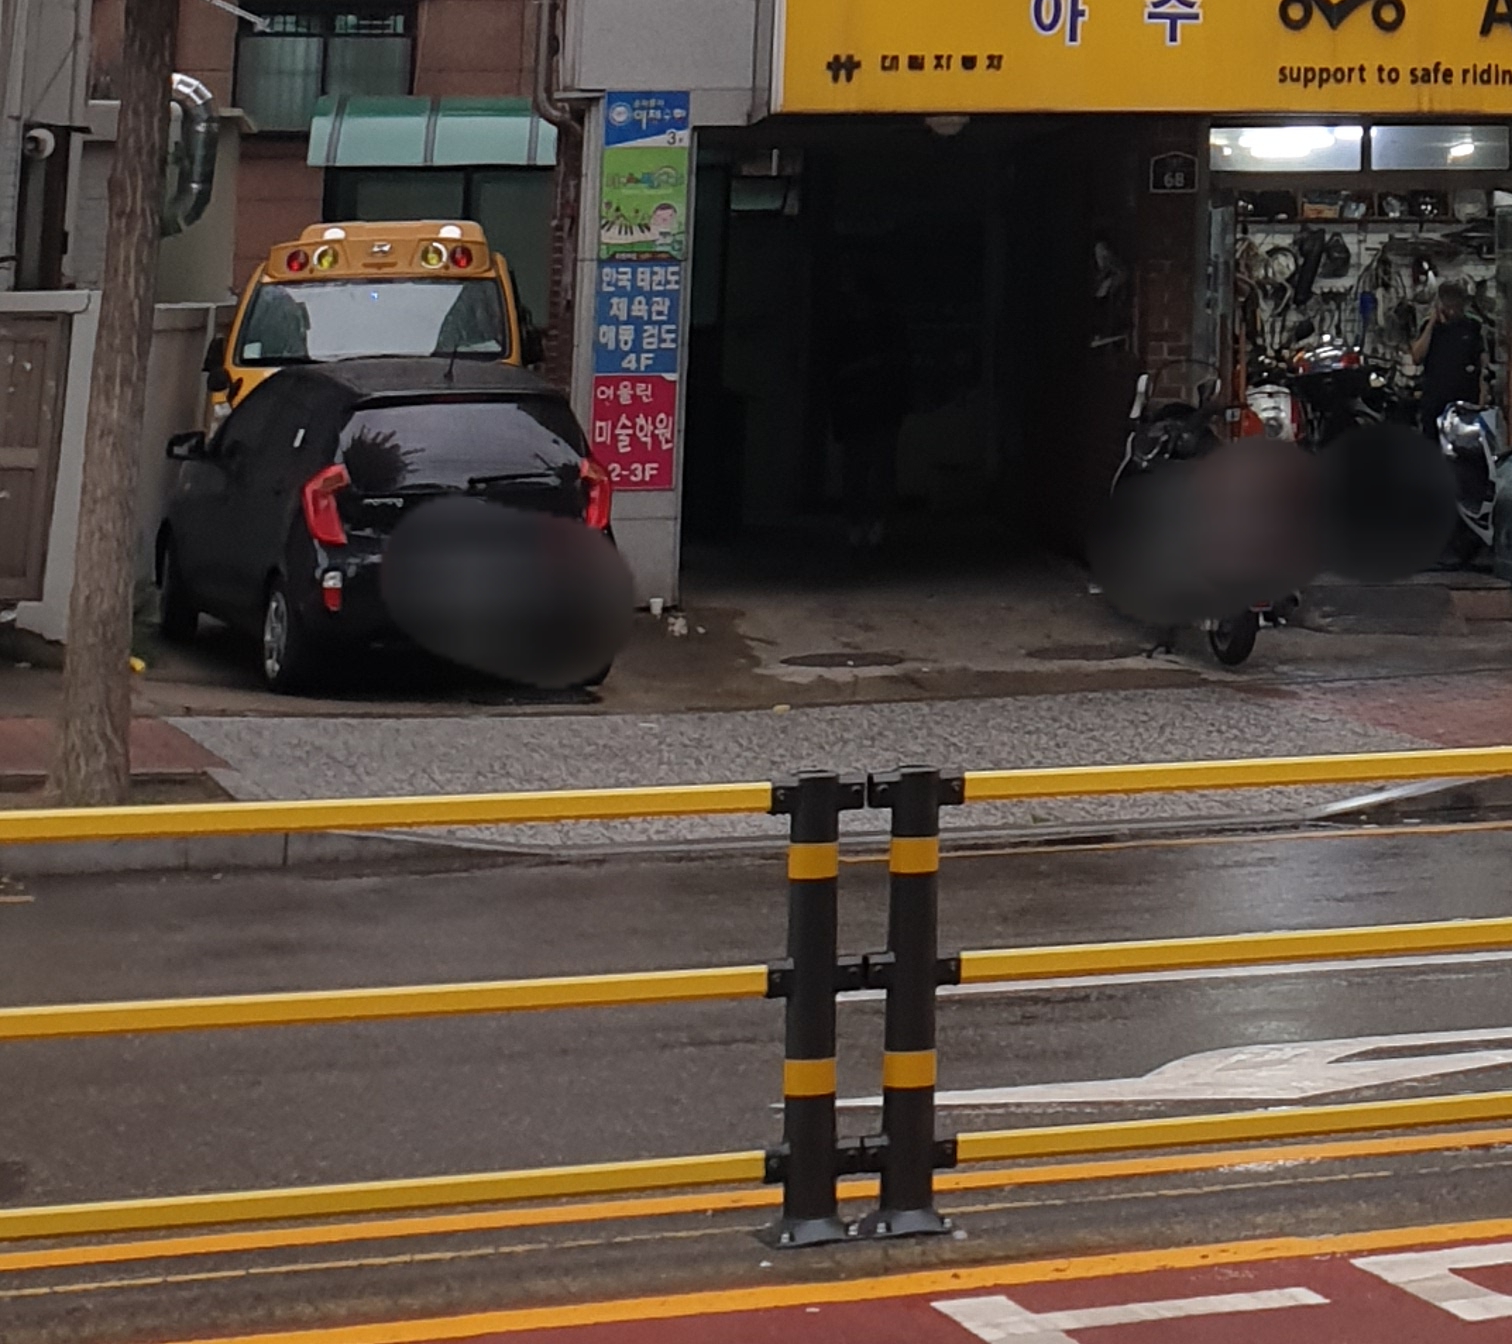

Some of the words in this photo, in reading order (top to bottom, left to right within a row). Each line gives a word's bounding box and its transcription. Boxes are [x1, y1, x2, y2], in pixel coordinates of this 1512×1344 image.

[1278, 62, 1366, 89] support
[1377, 64, 1401, 85] to
[1409, 61, 1453, 86] safe
[636, 267, 680, 291] 태권도
[610, 296, 671, 321] 체육관
[642, 324, 677, 349] 검도
[621, 353, 655, 371] 4F
[595, 413, 673, 453] 미술학원
[608, 462, 660, 482] 2-3F
